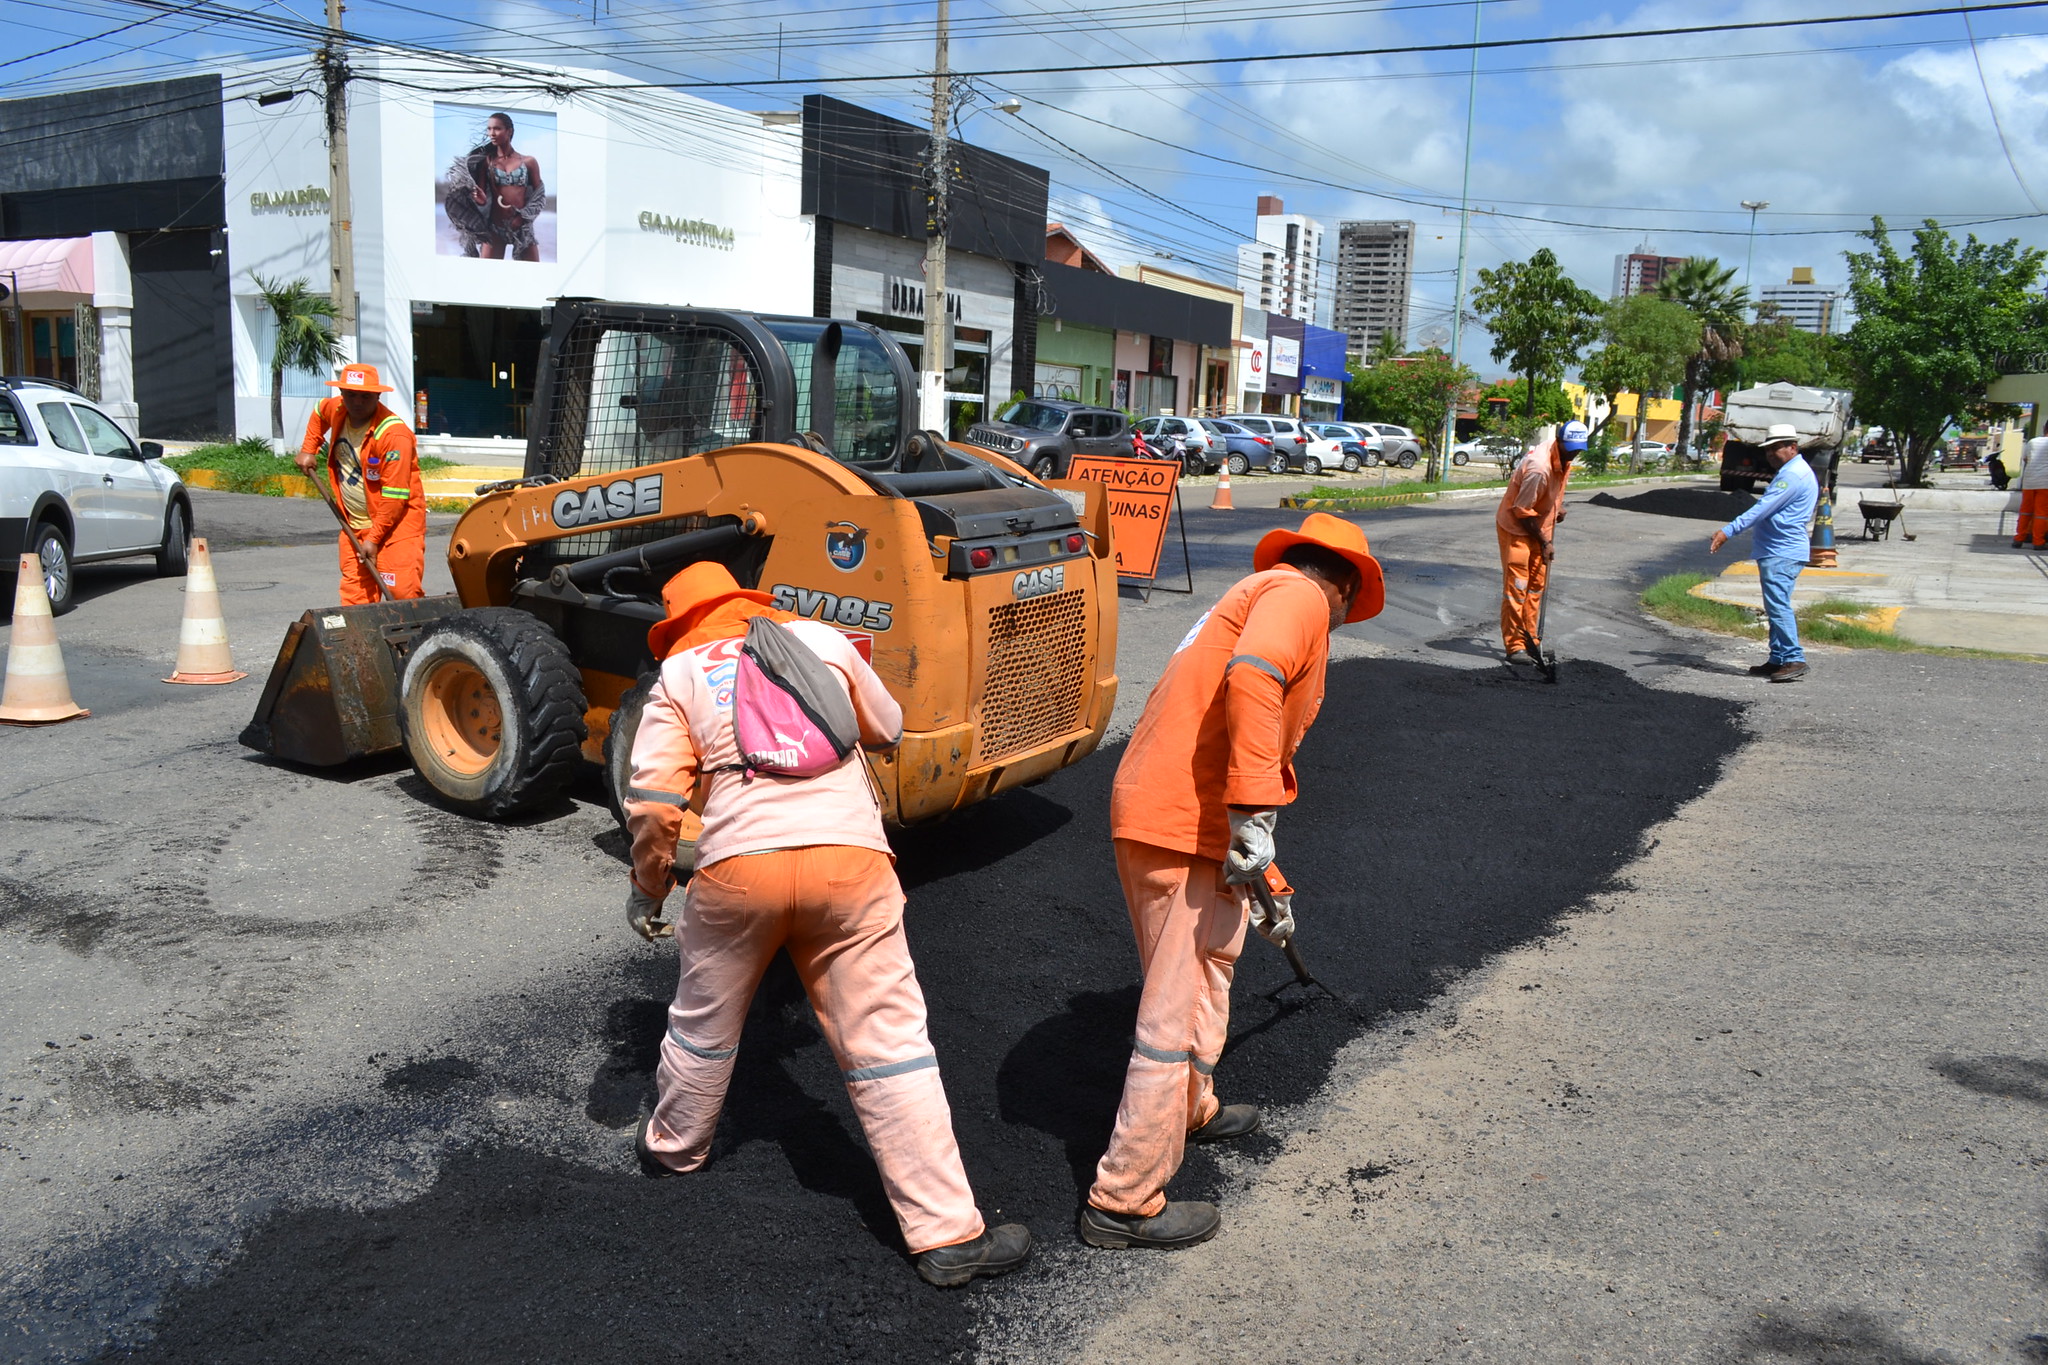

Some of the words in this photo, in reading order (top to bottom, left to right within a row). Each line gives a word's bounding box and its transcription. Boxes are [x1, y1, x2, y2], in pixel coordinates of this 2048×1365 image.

[676, 234, 734, 252] beachwear
[1078, 467, 1165, 488] ATENÇÃO
[552, 474, 662, 527] CASE
[1109, 501, 1161, 519] UINAS
[1012, 565, 1064, 599] CASE
[771, 584, 893, 631] SV185
